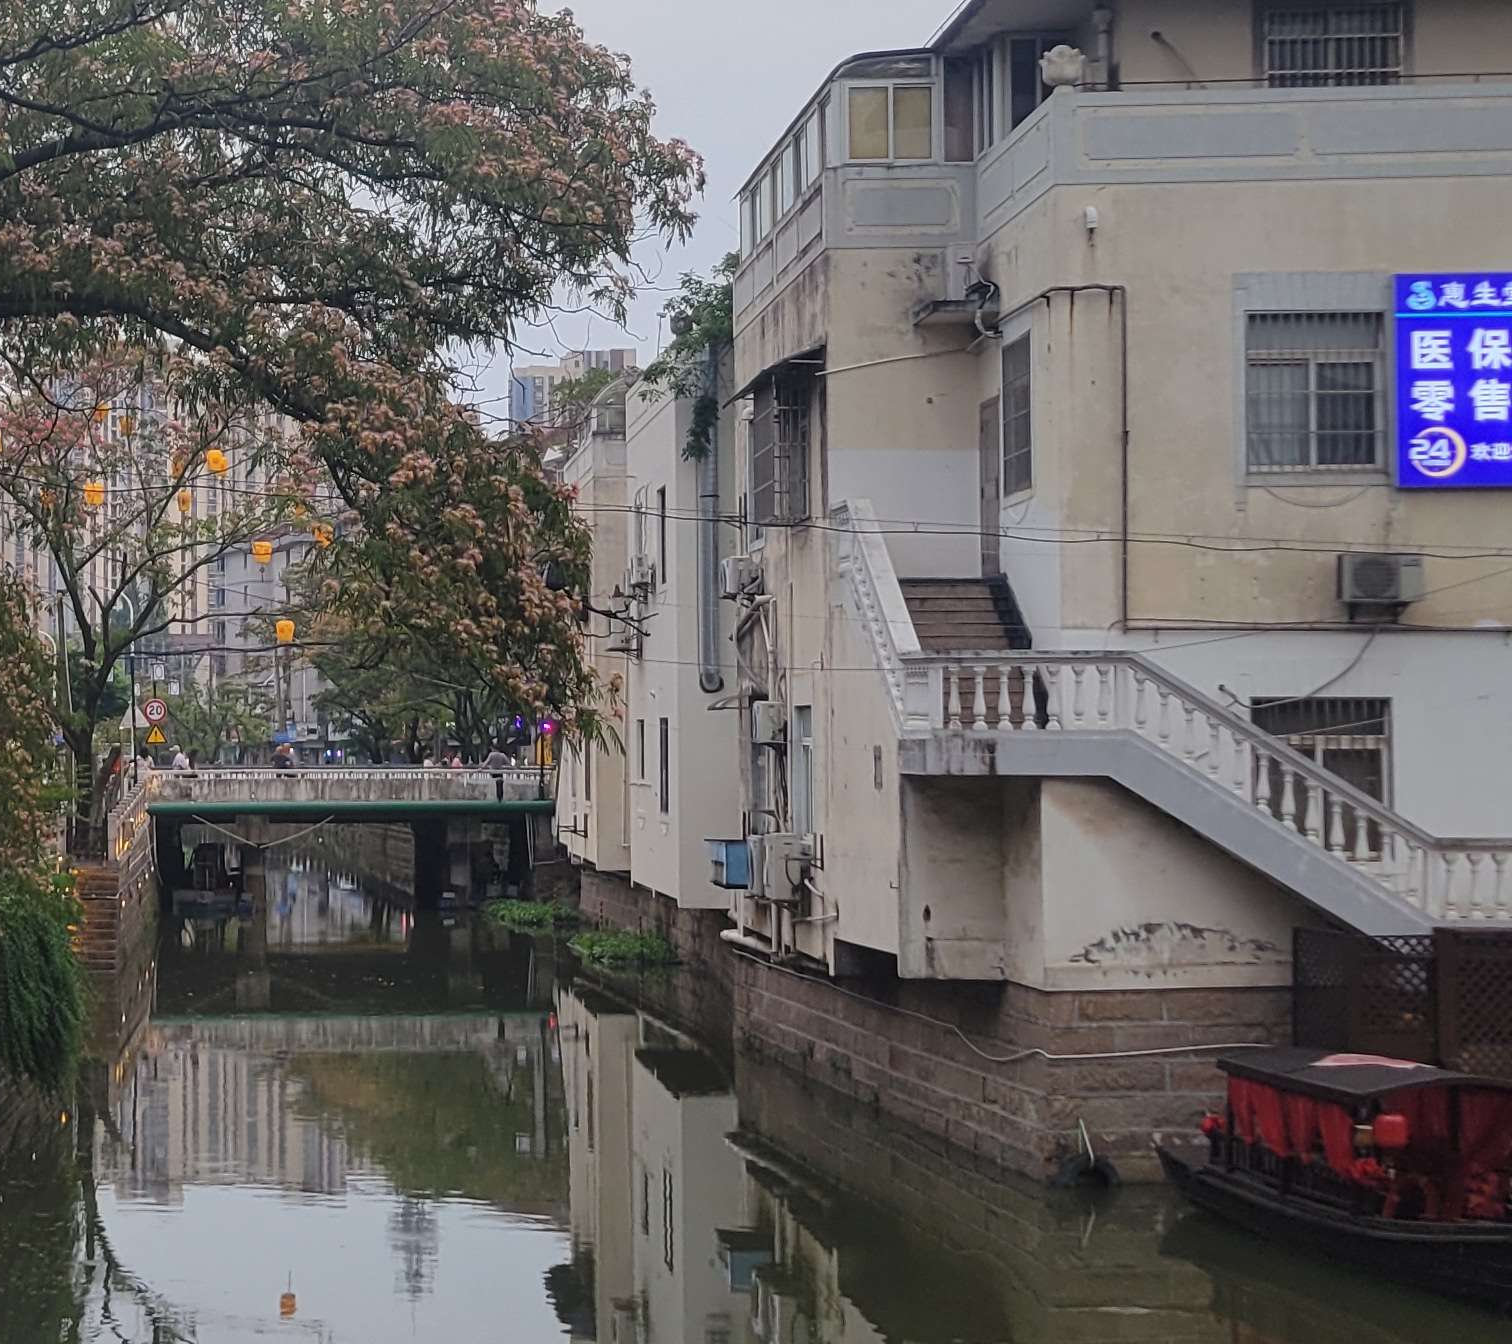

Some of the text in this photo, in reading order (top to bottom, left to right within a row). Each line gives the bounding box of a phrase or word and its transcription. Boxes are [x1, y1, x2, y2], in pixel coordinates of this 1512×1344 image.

[1410, 328, 1512, 370] 医保
[1410, 378, 1512, 422] 零售
[1409, 439, 1451, 460] 24
[1469, 442, 1512, 460] 欢迎
[149, 705, 162, 715] 20
